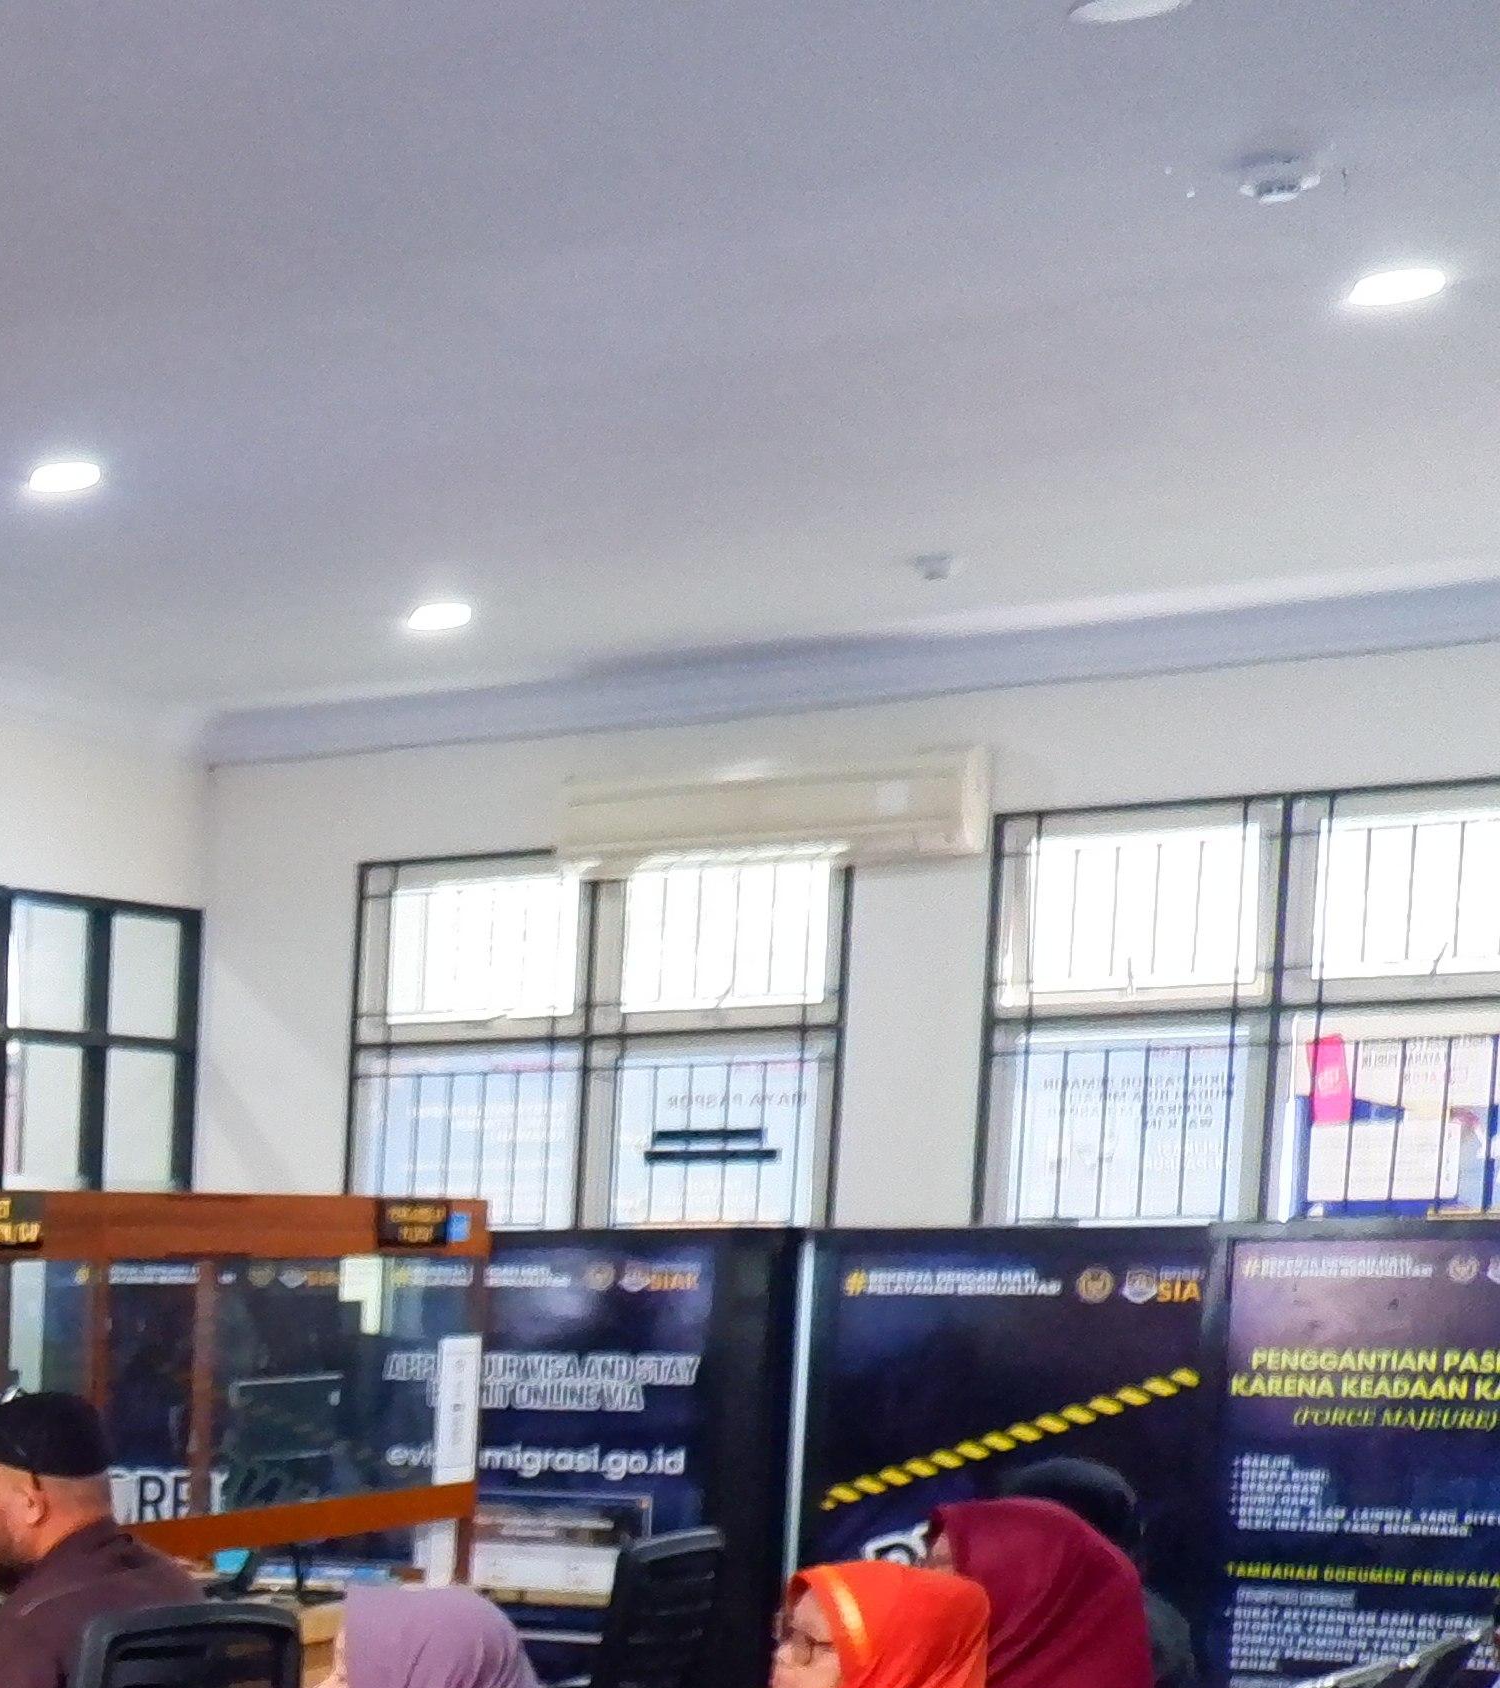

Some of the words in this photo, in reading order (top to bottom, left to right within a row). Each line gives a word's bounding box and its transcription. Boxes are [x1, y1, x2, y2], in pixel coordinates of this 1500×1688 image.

[1250, 1346, 1438, 1373] PENGGANTIAN
[1442, 1349, 1500, 1375] PAS
[1230, 1373, 1336, 1398] KARENA
[1340, 1374, 1469, 1401] KEADAAN
[1323, 1564, 1407, 1585] DOKUMEN
